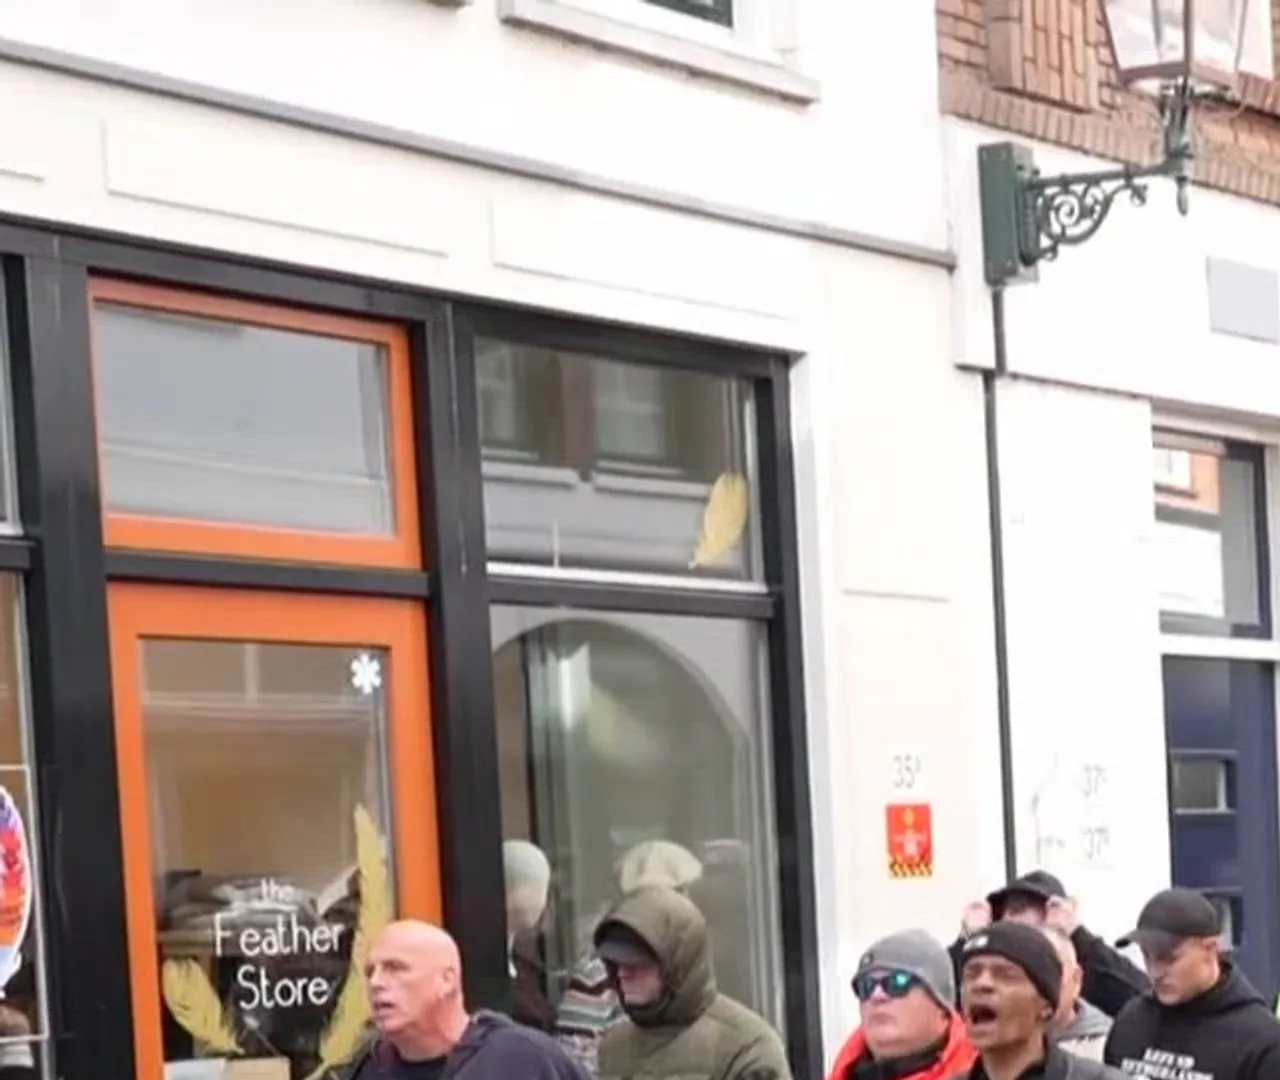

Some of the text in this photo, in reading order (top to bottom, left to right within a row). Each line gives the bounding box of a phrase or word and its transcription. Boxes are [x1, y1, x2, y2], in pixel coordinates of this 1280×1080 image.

[261, 878, 295, 900] the
[214, 911, 345, 957] Feather
[237, 964, 329, 1010] Store
